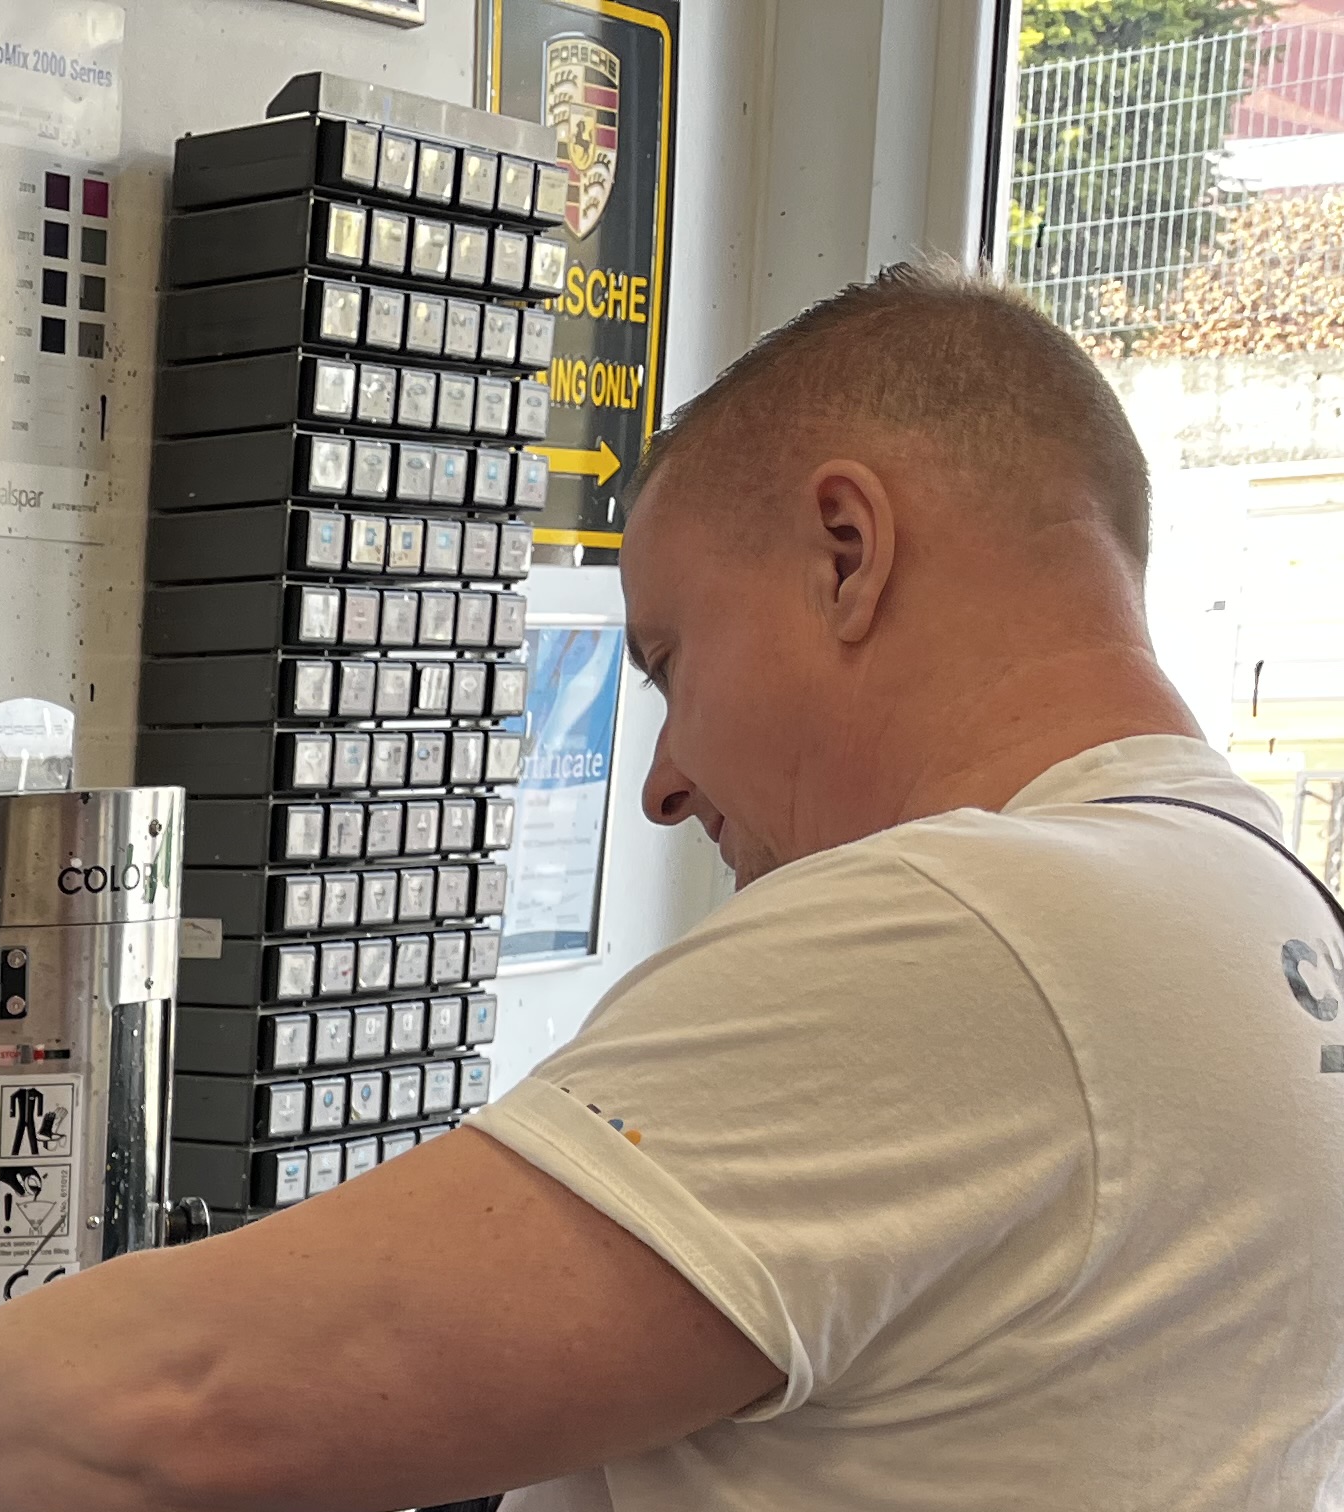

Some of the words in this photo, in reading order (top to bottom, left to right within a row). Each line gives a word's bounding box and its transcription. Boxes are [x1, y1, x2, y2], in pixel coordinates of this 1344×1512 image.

[33, 50, 66, 78] 2000
[70, 56, 113, 89] Series
[549, 44, 617, 79] PORSCHE
[564, 266, 648, 323] SCHE
[591, 362, 641, 410] ONLY
[522, 751, 603, 779] rtificate
